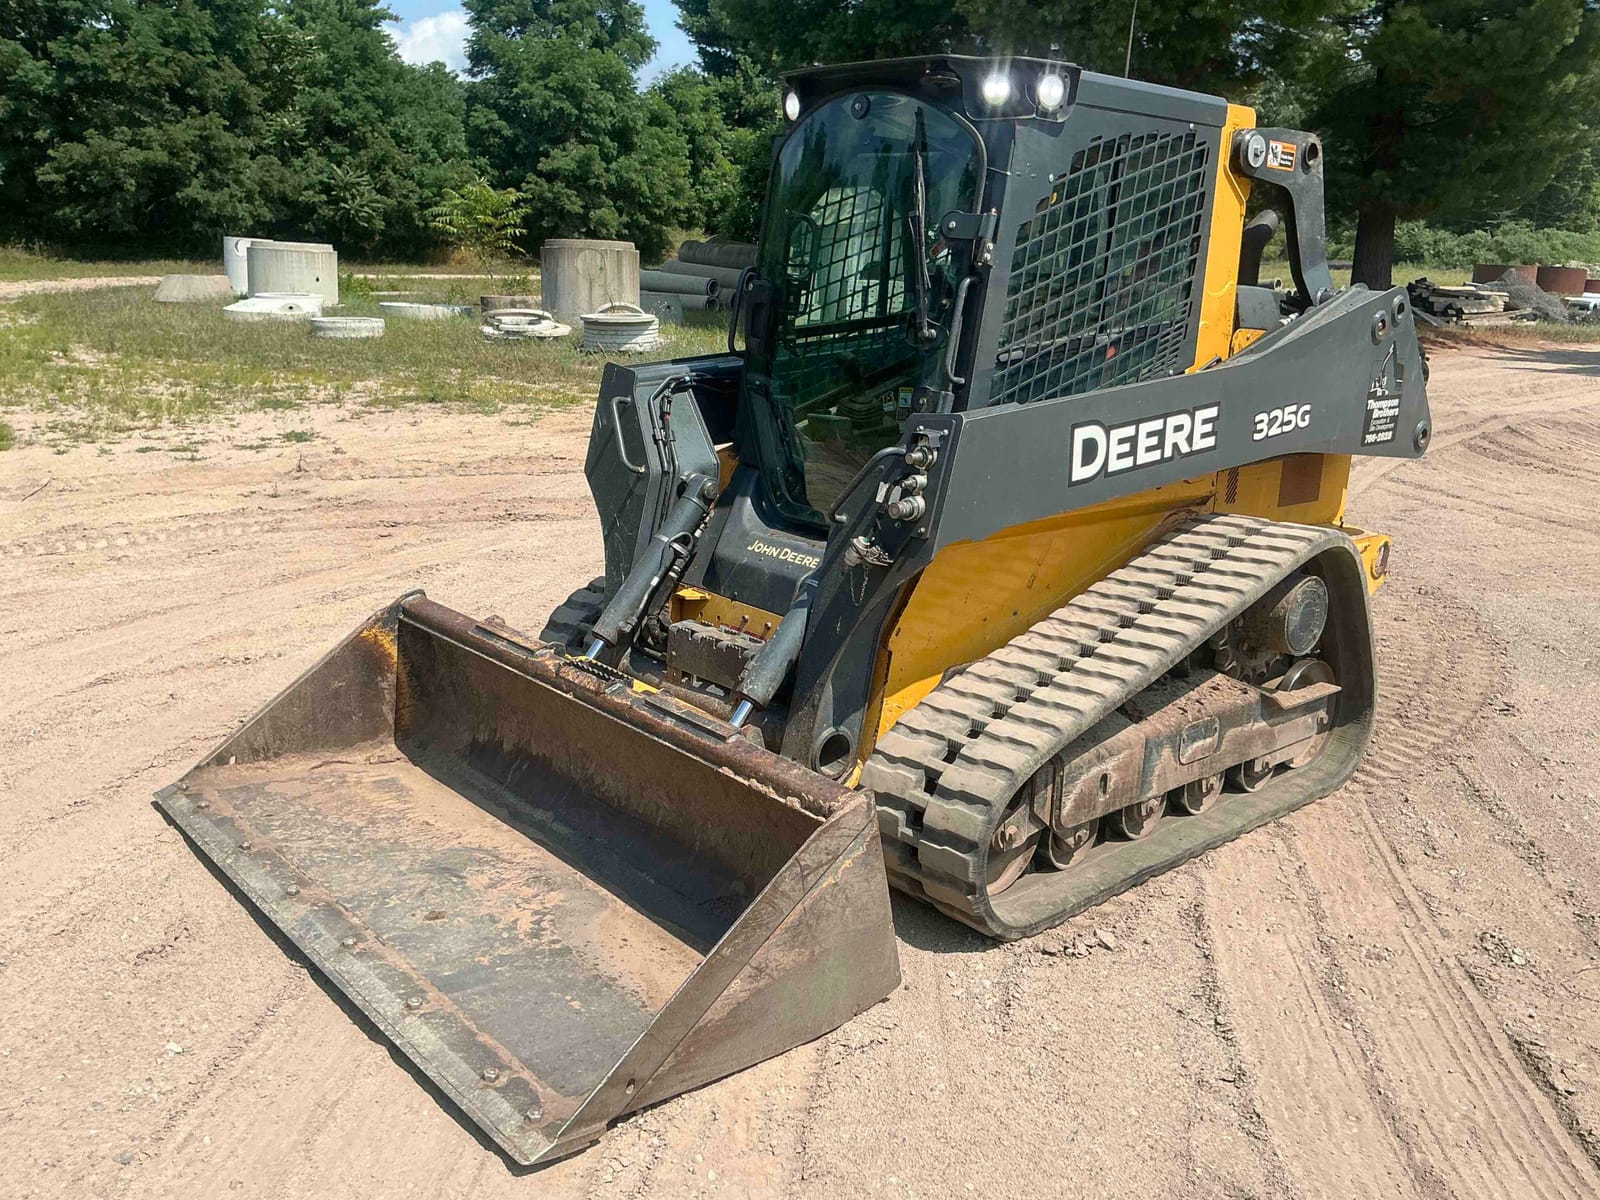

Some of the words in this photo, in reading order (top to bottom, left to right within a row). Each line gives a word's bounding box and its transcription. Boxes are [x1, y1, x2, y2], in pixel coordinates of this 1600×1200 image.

[1367, 399, 1399, 410] Thompson
[1372, 408, 1399, 418] Brothers
[1252, 403, 1312, 441] 325G
[1070, 405, 1220, 483] DEERE
[747, 540, 780, 557] JOHN
[780, 548, 820, 569] DEERE
